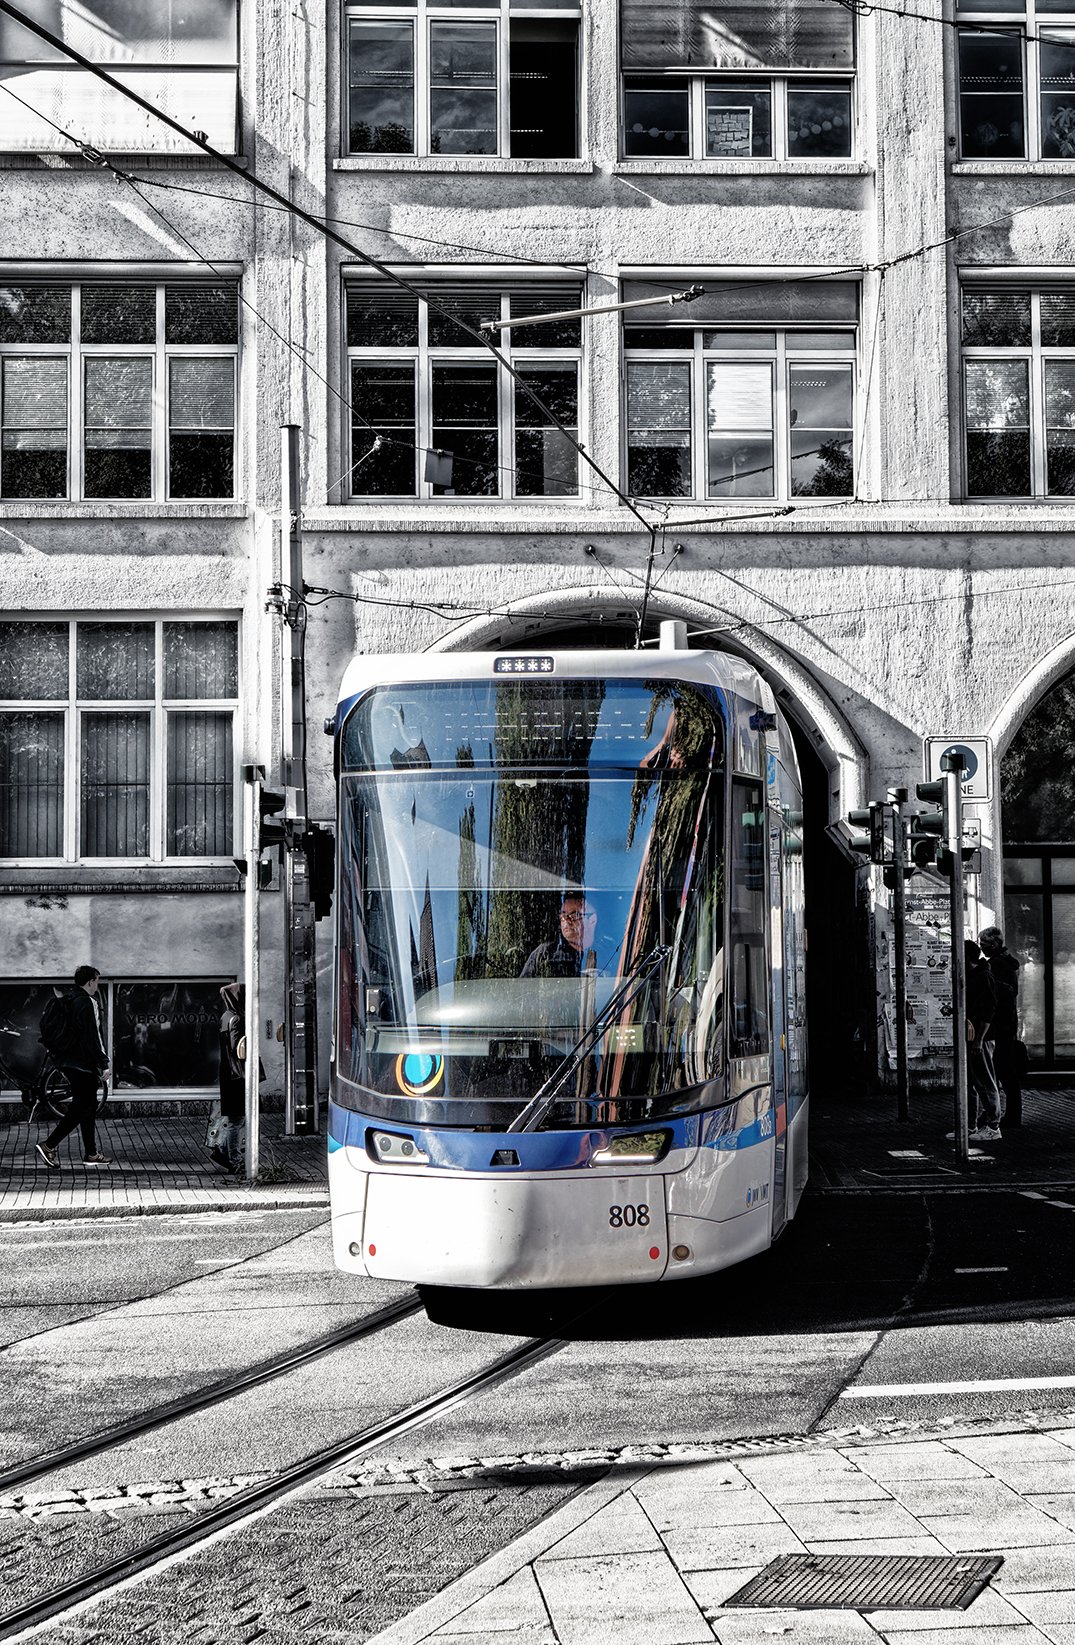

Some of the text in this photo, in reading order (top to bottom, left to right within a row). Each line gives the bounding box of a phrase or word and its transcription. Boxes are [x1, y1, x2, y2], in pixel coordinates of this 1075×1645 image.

[960, 785, 974, 795] NE
[127, 1014, 217, 1024] VERO MODA
[609, 1203, 650, 1228] 808
